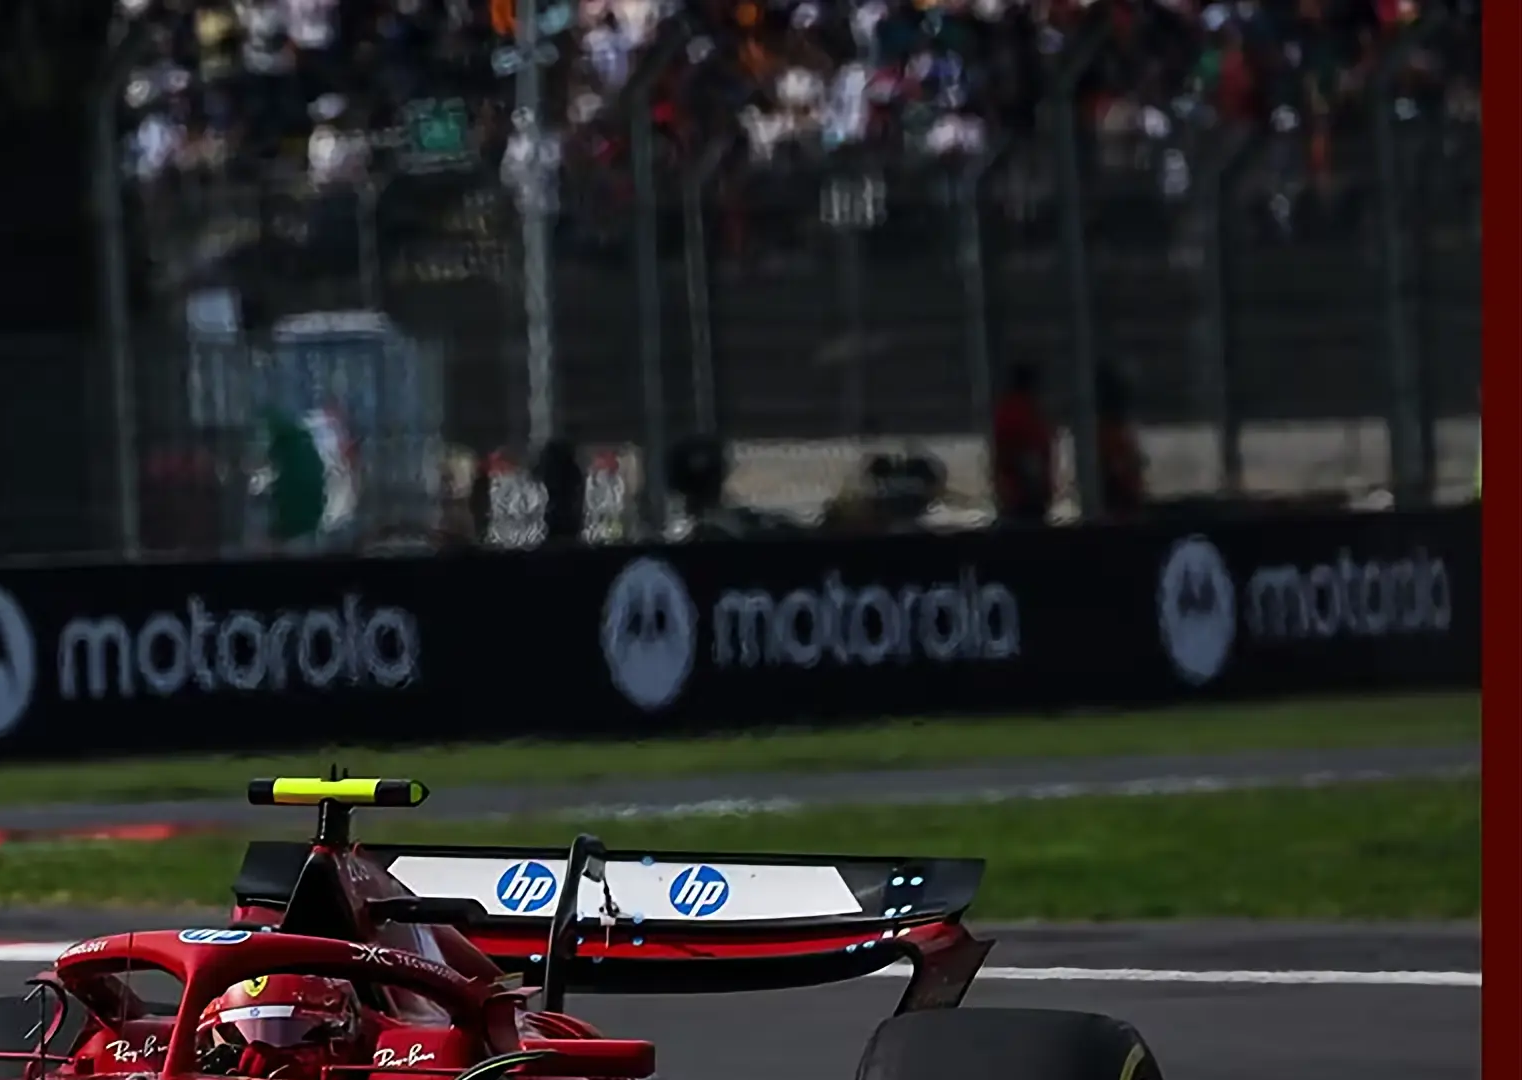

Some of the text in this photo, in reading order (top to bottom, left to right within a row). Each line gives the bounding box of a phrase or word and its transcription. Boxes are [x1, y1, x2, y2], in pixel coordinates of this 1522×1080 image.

[56, 592, 421, 701] motorola
[711, 566, 1022, 668] motorola
[500, 860, 555, 912] hp
[673, 865, 727, 917] hp
